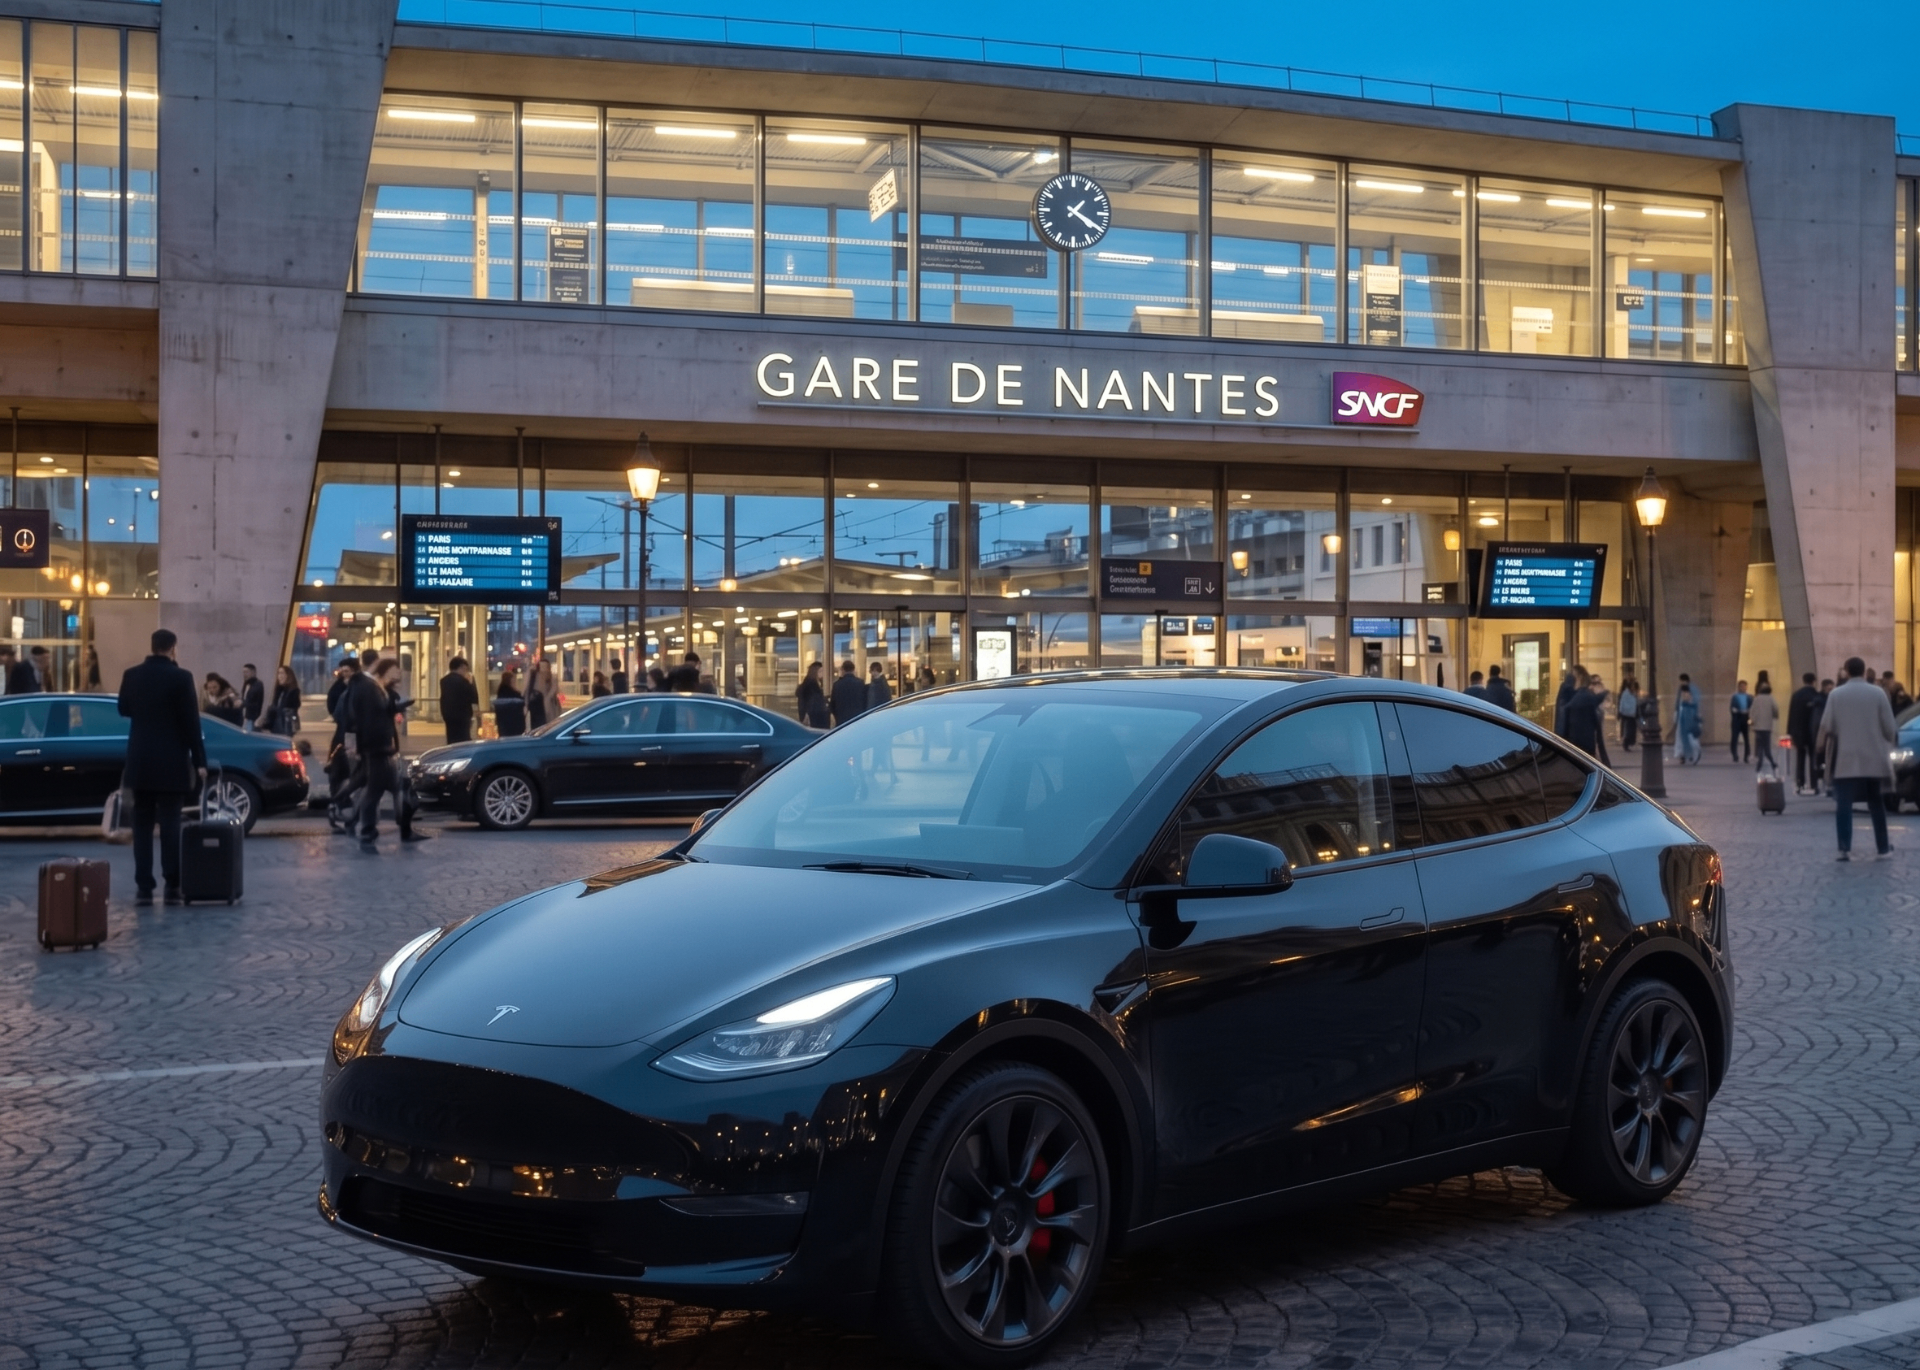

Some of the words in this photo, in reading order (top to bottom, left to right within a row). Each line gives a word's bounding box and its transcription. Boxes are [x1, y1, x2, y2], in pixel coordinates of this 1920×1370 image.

[757, 353, 920, 402] GARE
[952, 362, 1024, 408] DE
[1055, 367, 1280, 417] NANTES
[1337, 390, 1420, 418] SNCF
[428, 534, 451, 543] PARIS
[428, 545, 450, 554] PARIS
[451, 546, 512, 555] MONTPARNASSE
[428, 567, 437, 575] LE
[440, 567, 463, 576] MANS
